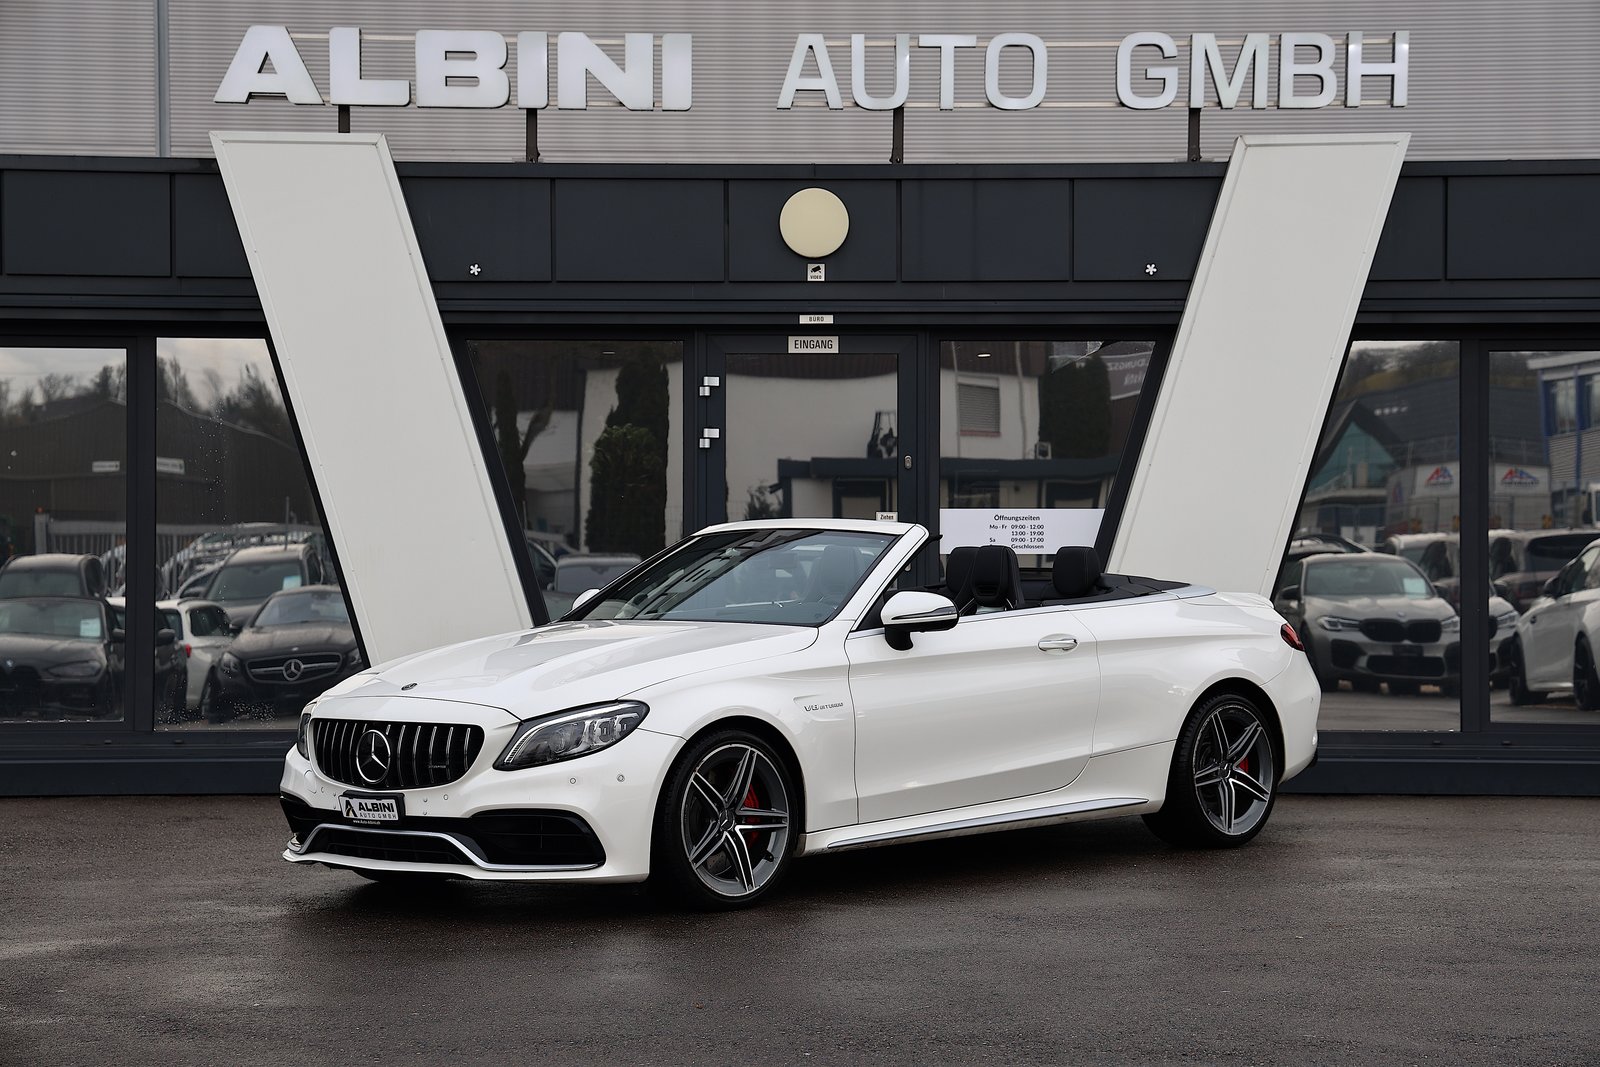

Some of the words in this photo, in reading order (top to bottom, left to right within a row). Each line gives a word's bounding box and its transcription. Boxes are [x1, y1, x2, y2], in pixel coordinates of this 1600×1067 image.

[213, 25, 693, 111] ALBINI
[777, 32, 1048, 110] AUTO
[1115, 31, 1410, 109] GMBH
[794, 339, 833, 349] EINGANG
[993, 514, 1041, 522] Öffnungszeiten
[358, 801, 395, 812] ALBINI
